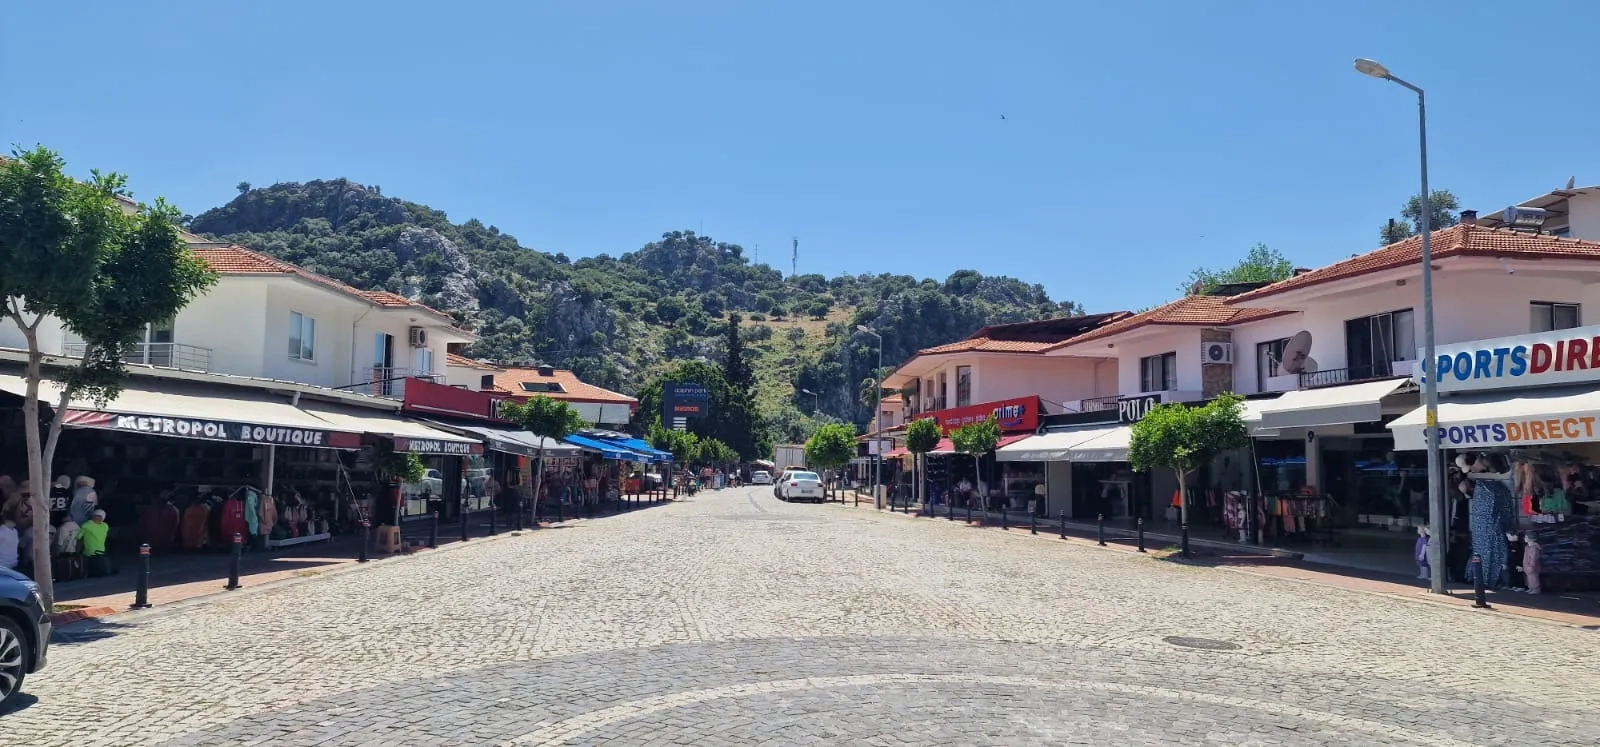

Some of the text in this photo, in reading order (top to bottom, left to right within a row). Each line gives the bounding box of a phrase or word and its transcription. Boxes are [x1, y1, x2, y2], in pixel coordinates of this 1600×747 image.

[1119, 397, 1155, 421] POLO
[117, 415, 323, 445] METROPOL BOUTIQUE
[409, 439, 470, 454] METROPOL BOUTIQUE
